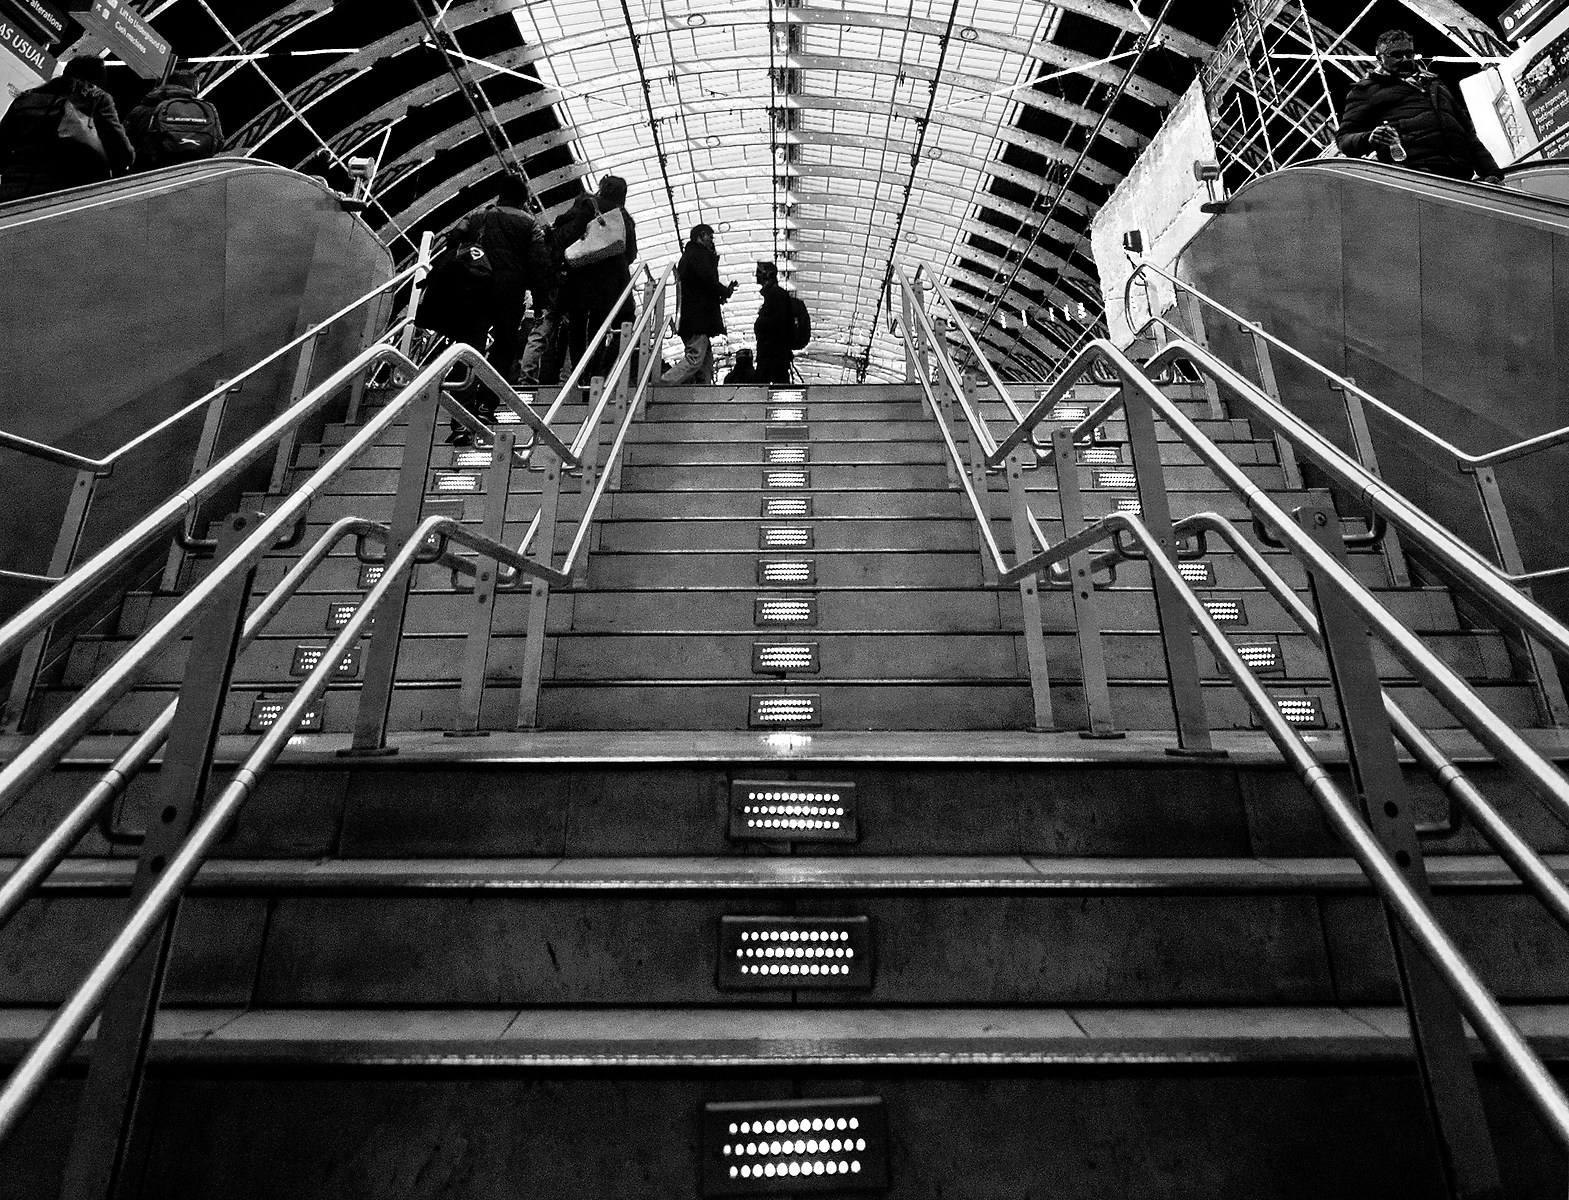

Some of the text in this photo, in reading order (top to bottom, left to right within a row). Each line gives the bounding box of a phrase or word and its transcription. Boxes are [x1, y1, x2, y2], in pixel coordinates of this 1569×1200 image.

[30, 0, 63, 32] alterations
[1513, 2, 1532, 19] Train
[0, 23, 46, 70] AS USUAL
